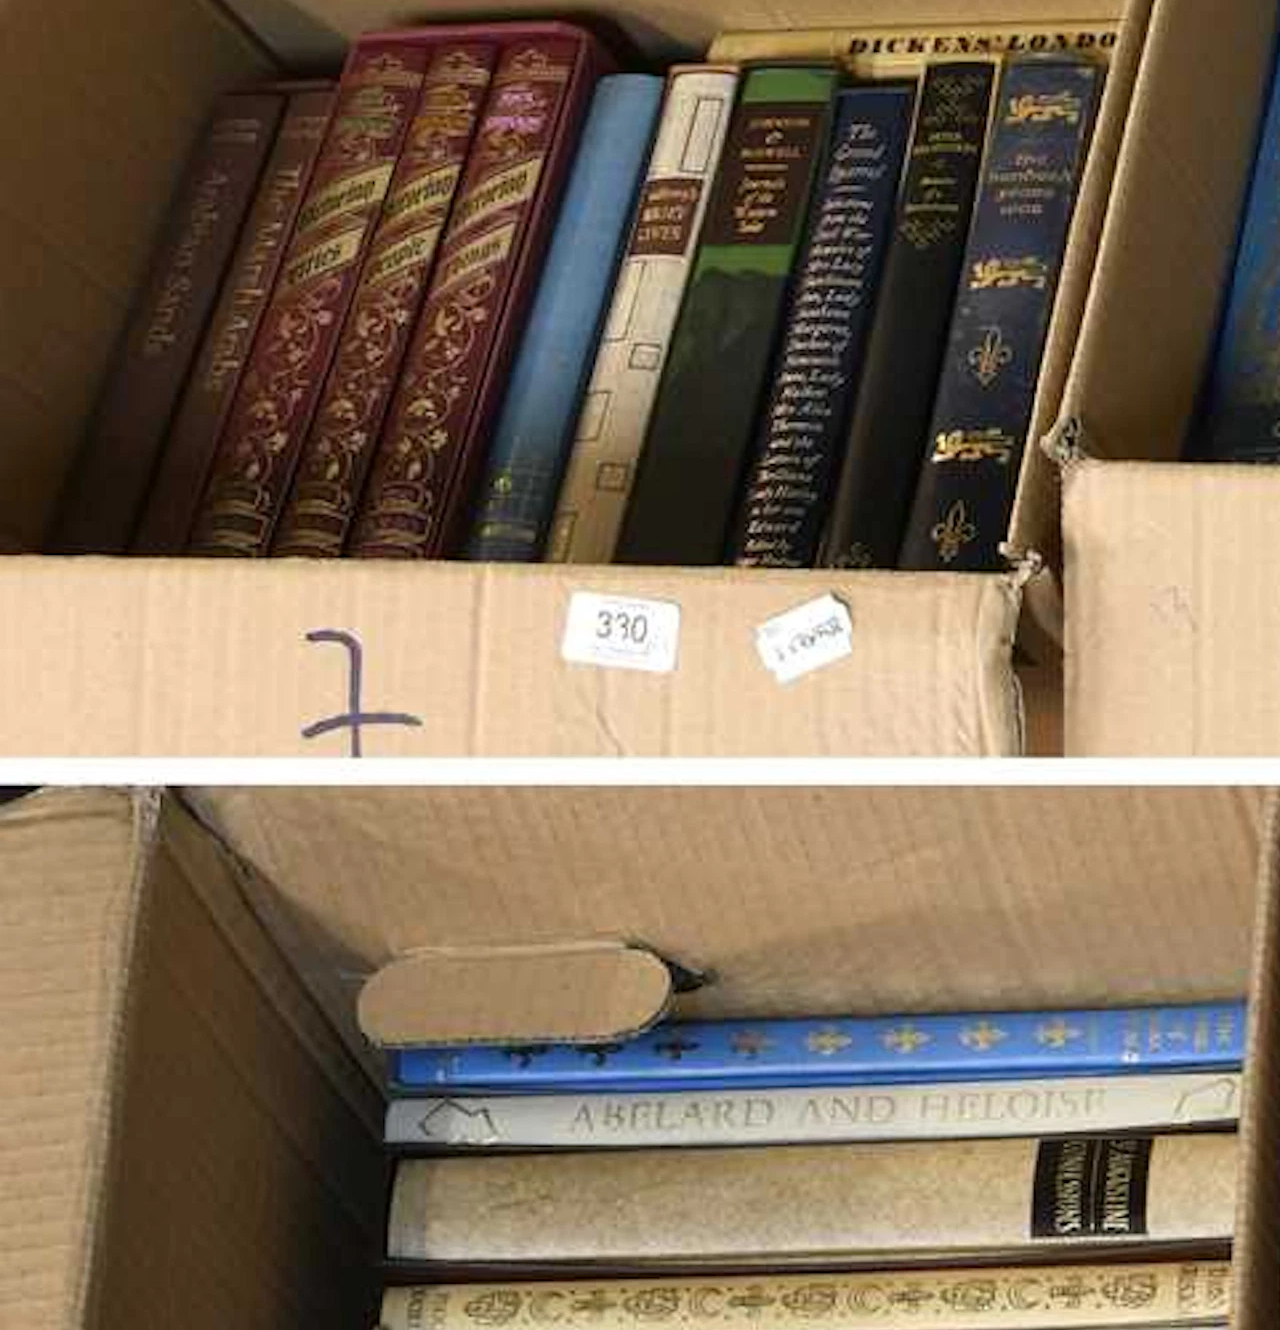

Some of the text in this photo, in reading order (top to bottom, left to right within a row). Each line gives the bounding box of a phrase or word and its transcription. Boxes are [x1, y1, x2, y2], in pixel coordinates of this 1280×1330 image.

[1007, 32, 1118, 51] LONDO
[595, 609, 649, 646] 330
[301, 629, 423, 757] 7
[570, 1085, 1108, 1135] ABELARD AND HELOISE
